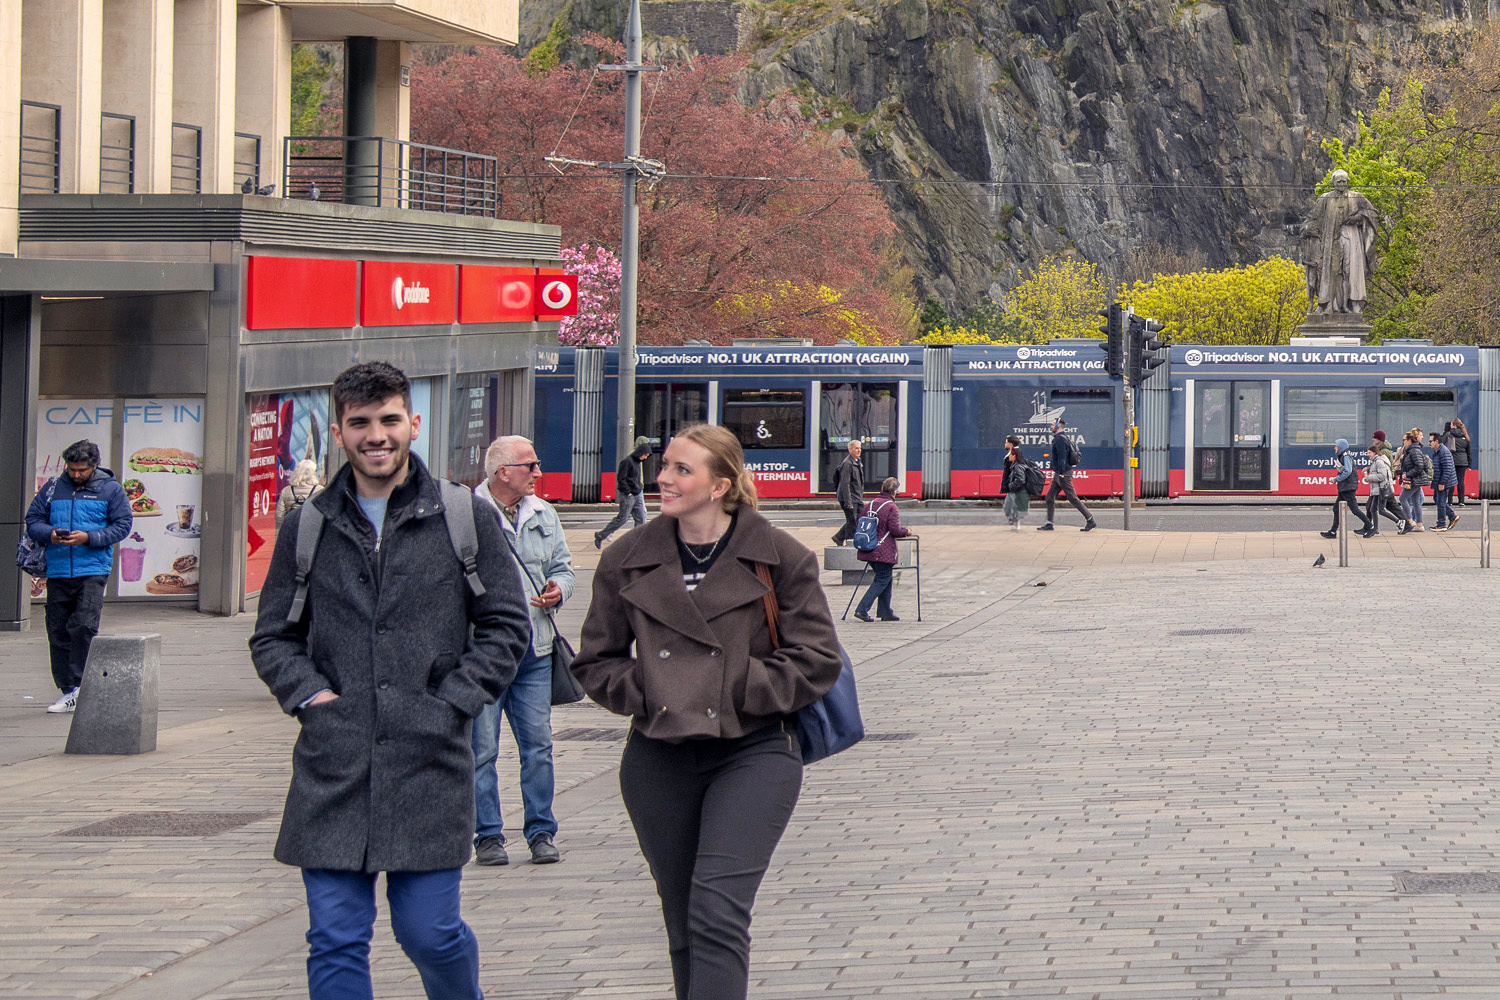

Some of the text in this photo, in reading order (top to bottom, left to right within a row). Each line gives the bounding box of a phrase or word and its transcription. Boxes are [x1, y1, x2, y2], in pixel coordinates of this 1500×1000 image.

[403, 281, 430, 304] vodafone
[1031, 349, 1077, 358] Tripadvisor
[640, 353, 909, 366] Tripadvisor NO.1 UK ATTRACTION (AGAIN)
[1202, 352, 1465, 366] Tripadvisor NO.1 UK ATTRACTION (AGAIN)
[968, 361, 992, 370] NO.1
[995, 361, 1010, 370] UK
[1013, 360, 1080, 370] ATTRACTION
[46, 401, 201, 425] CAFFÈ IN
[763, 463, 789, 471] STOP
[757, 472, 807, 481] TERMINAL
[1298, 476, 1327, 485] TRAM
